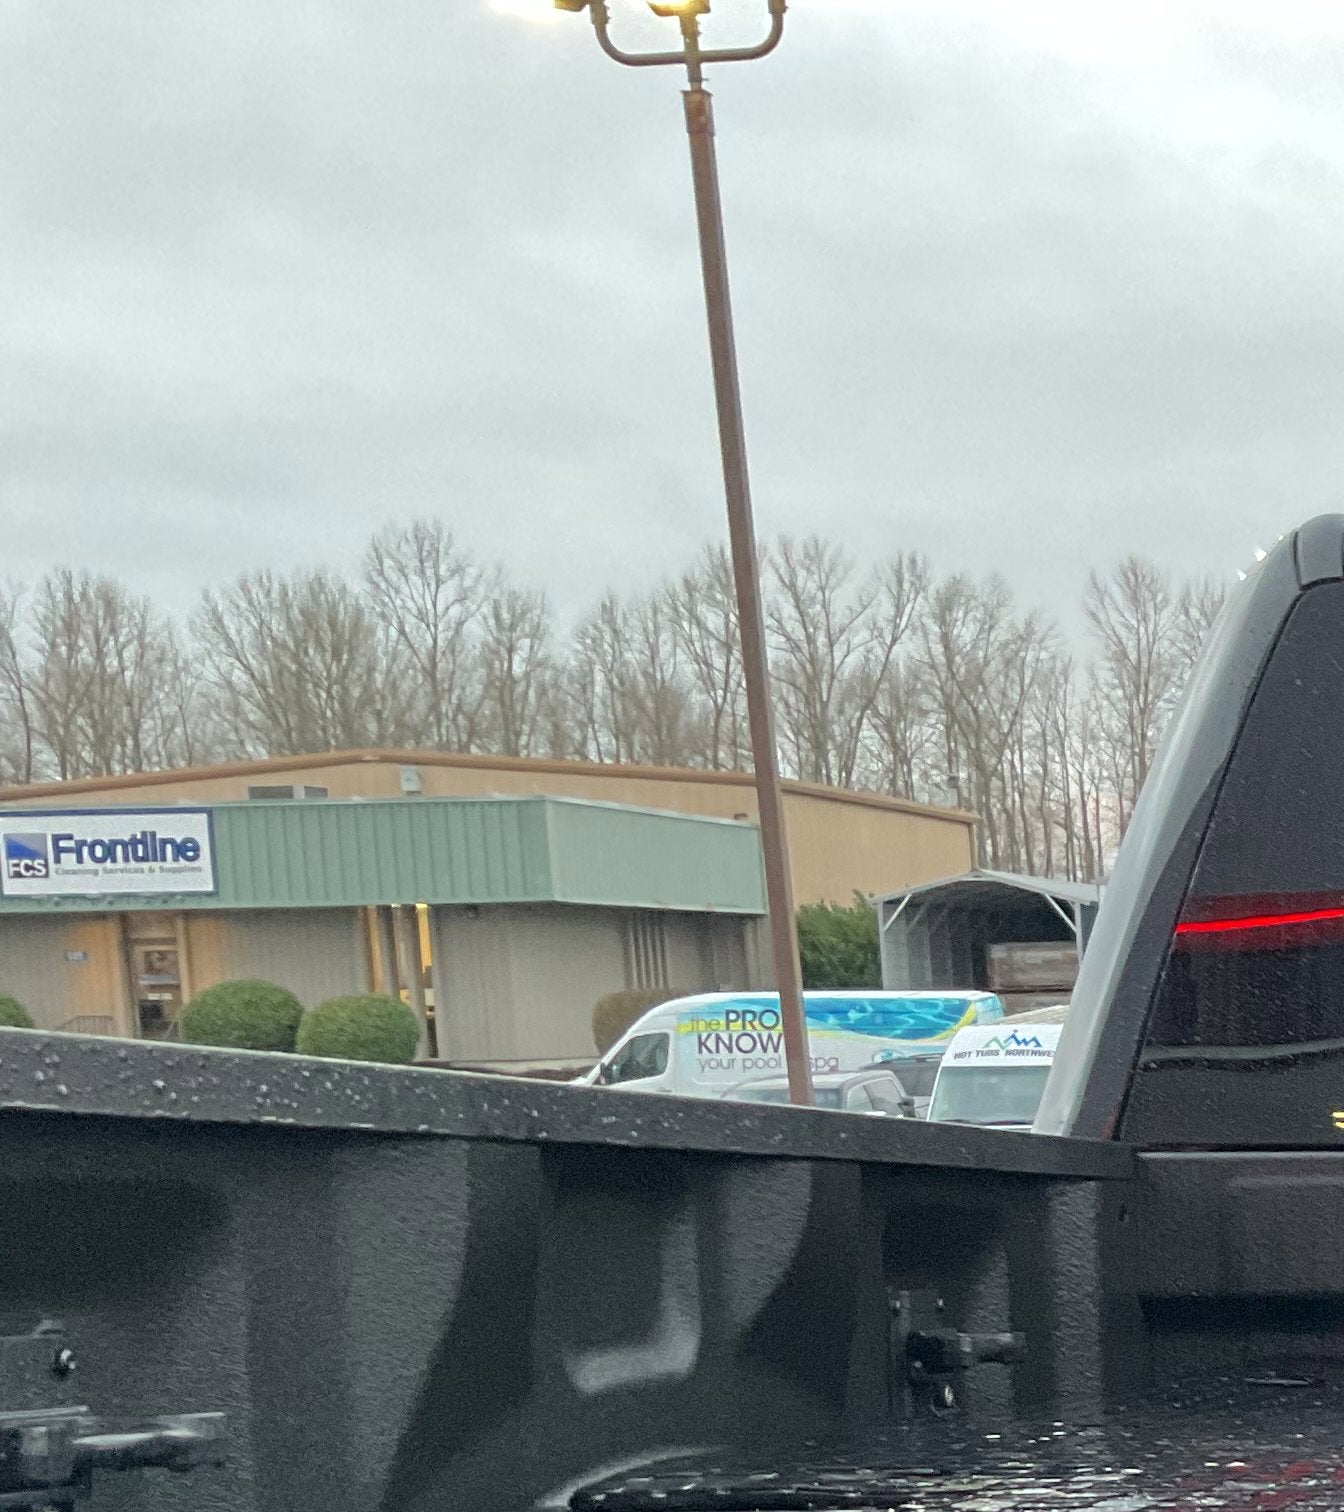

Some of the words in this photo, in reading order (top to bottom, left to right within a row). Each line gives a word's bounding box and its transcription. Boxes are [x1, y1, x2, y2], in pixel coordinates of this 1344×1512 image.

[51, 830, 201, 865] Frontline
[8, 859, 47, 877] FCS
[690, 1014, 721, 1032] the
[725, 1008, 780, 1031] PRO
[697, 1032, 783, 1054] KNOW
[697, 1055, 736, 1072] your
[743, 1053, 782, 1072] pool
